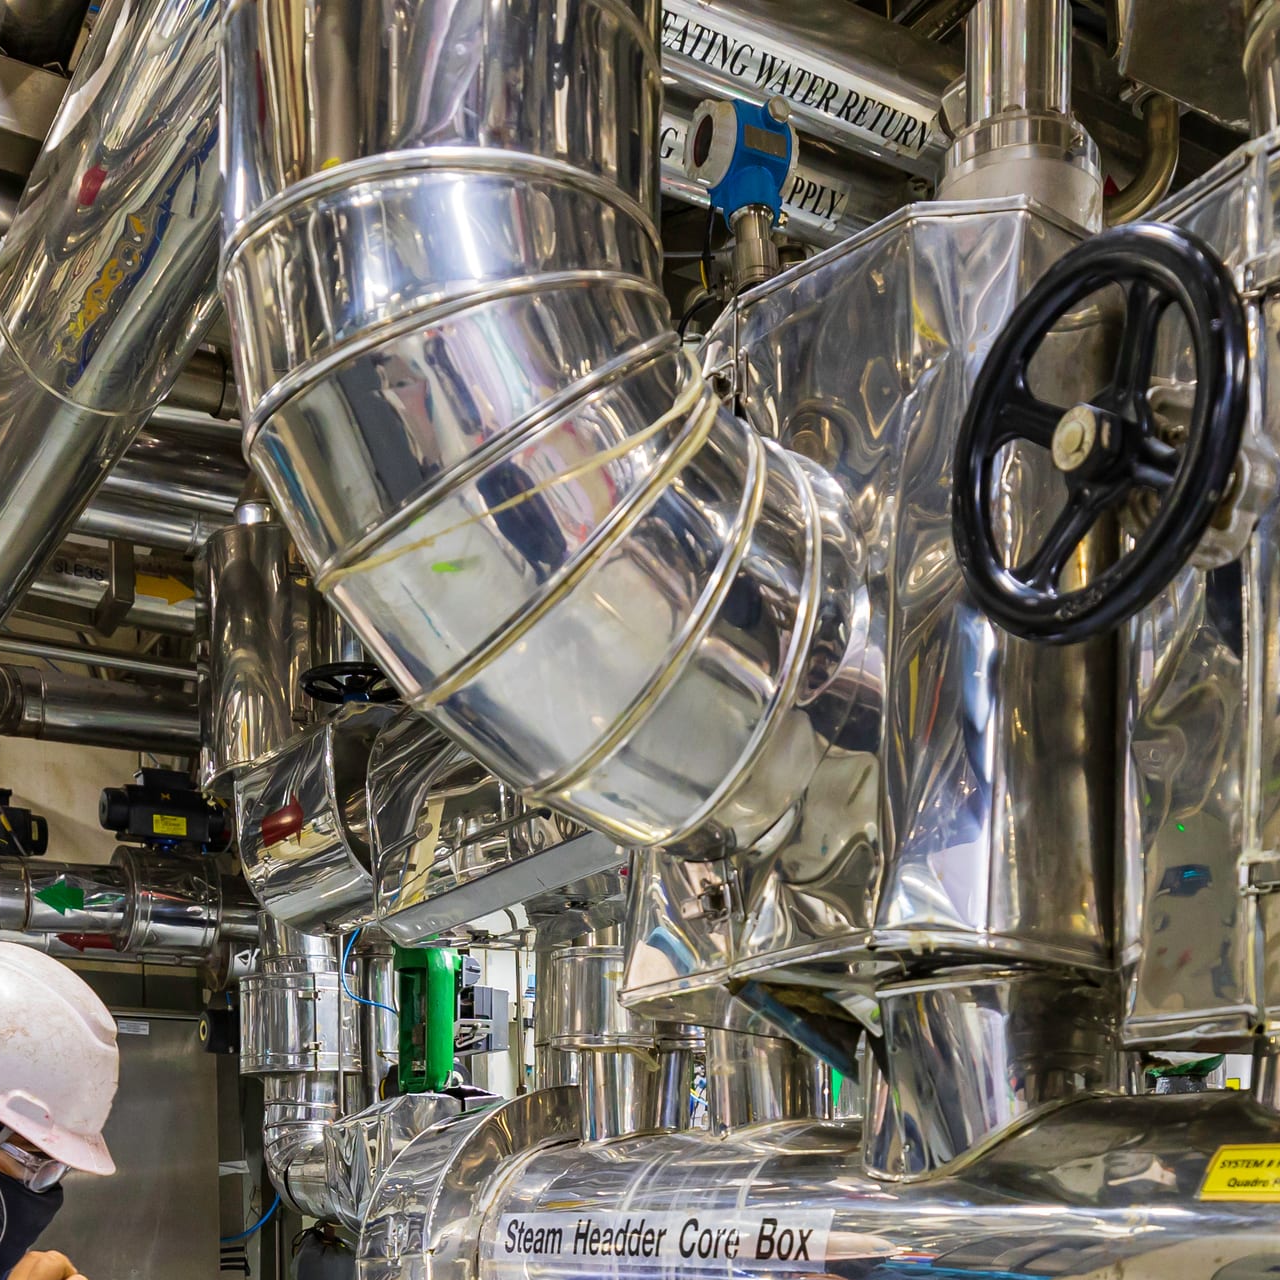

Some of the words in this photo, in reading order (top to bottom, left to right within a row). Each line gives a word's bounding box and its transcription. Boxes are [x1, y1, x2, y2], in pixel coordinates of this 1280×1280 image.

[754, 51, 839, 113] WATER
[835, 91, 933, 153] RETURN
[1220, 1159, 1264, 1169] SYSTEM
[1227, 1177, 1269, 1188] Quadro
[505, 1219, 563, 1255] Steam
[573, 1219, 668, 1258] Headder
[679, 1217, 740, 1260] Core
[756, 1218, 814, 1261] Box
